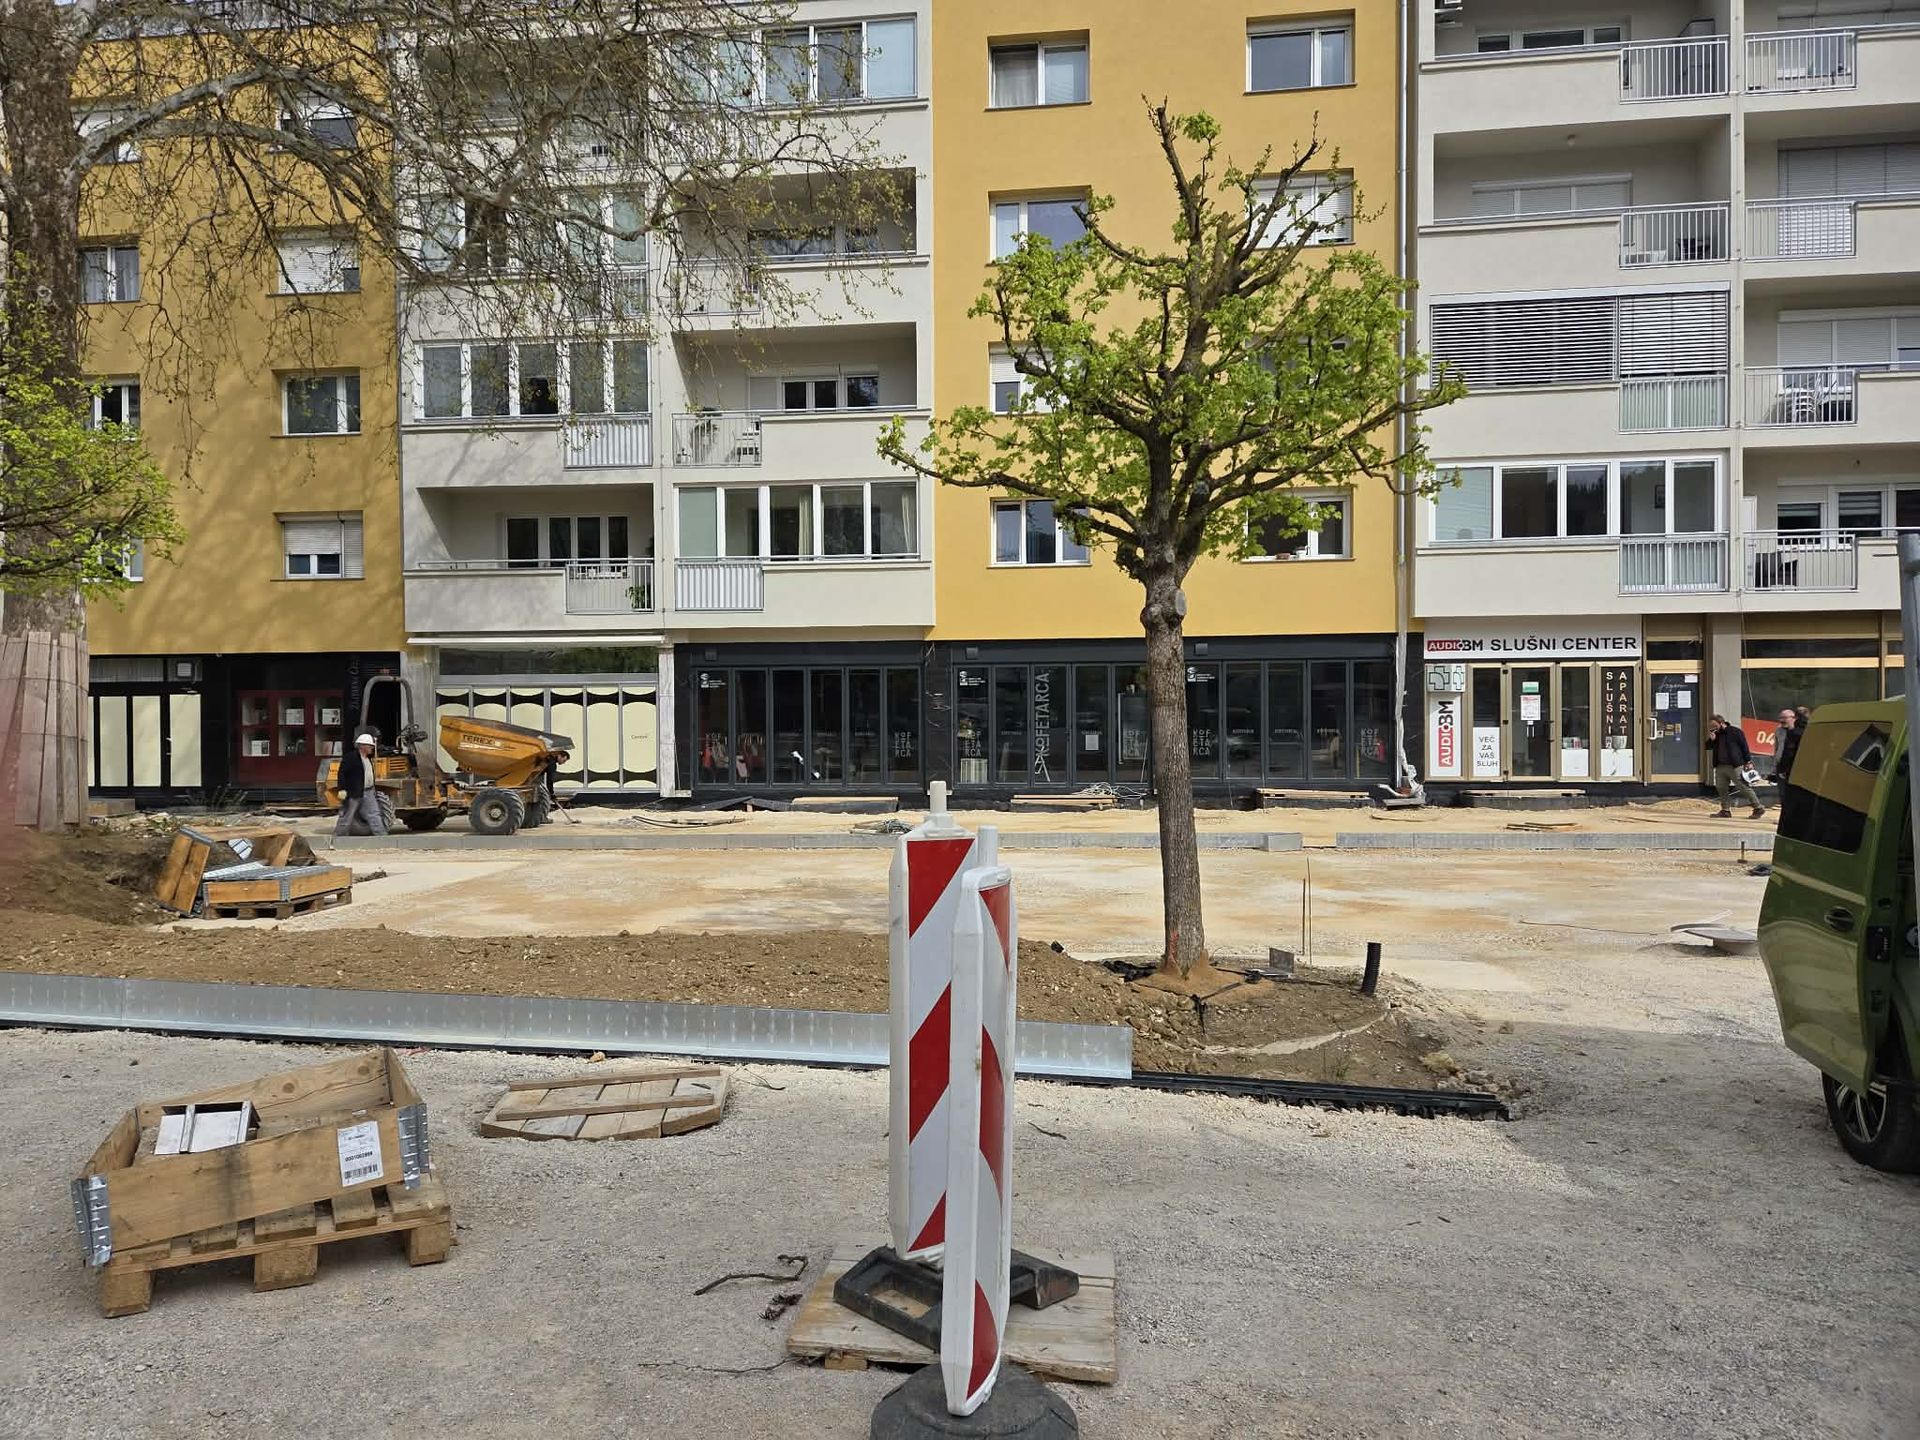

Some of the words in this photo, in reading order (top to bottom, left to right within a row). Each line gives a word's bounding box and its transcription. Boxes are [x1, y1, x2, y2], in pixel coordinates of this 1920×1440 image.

[1490, 635, 1556, 651] SLUŠNI
[1562, 637, 1637, 650] CENTER
[462, 734, 493, 746] TEREX
